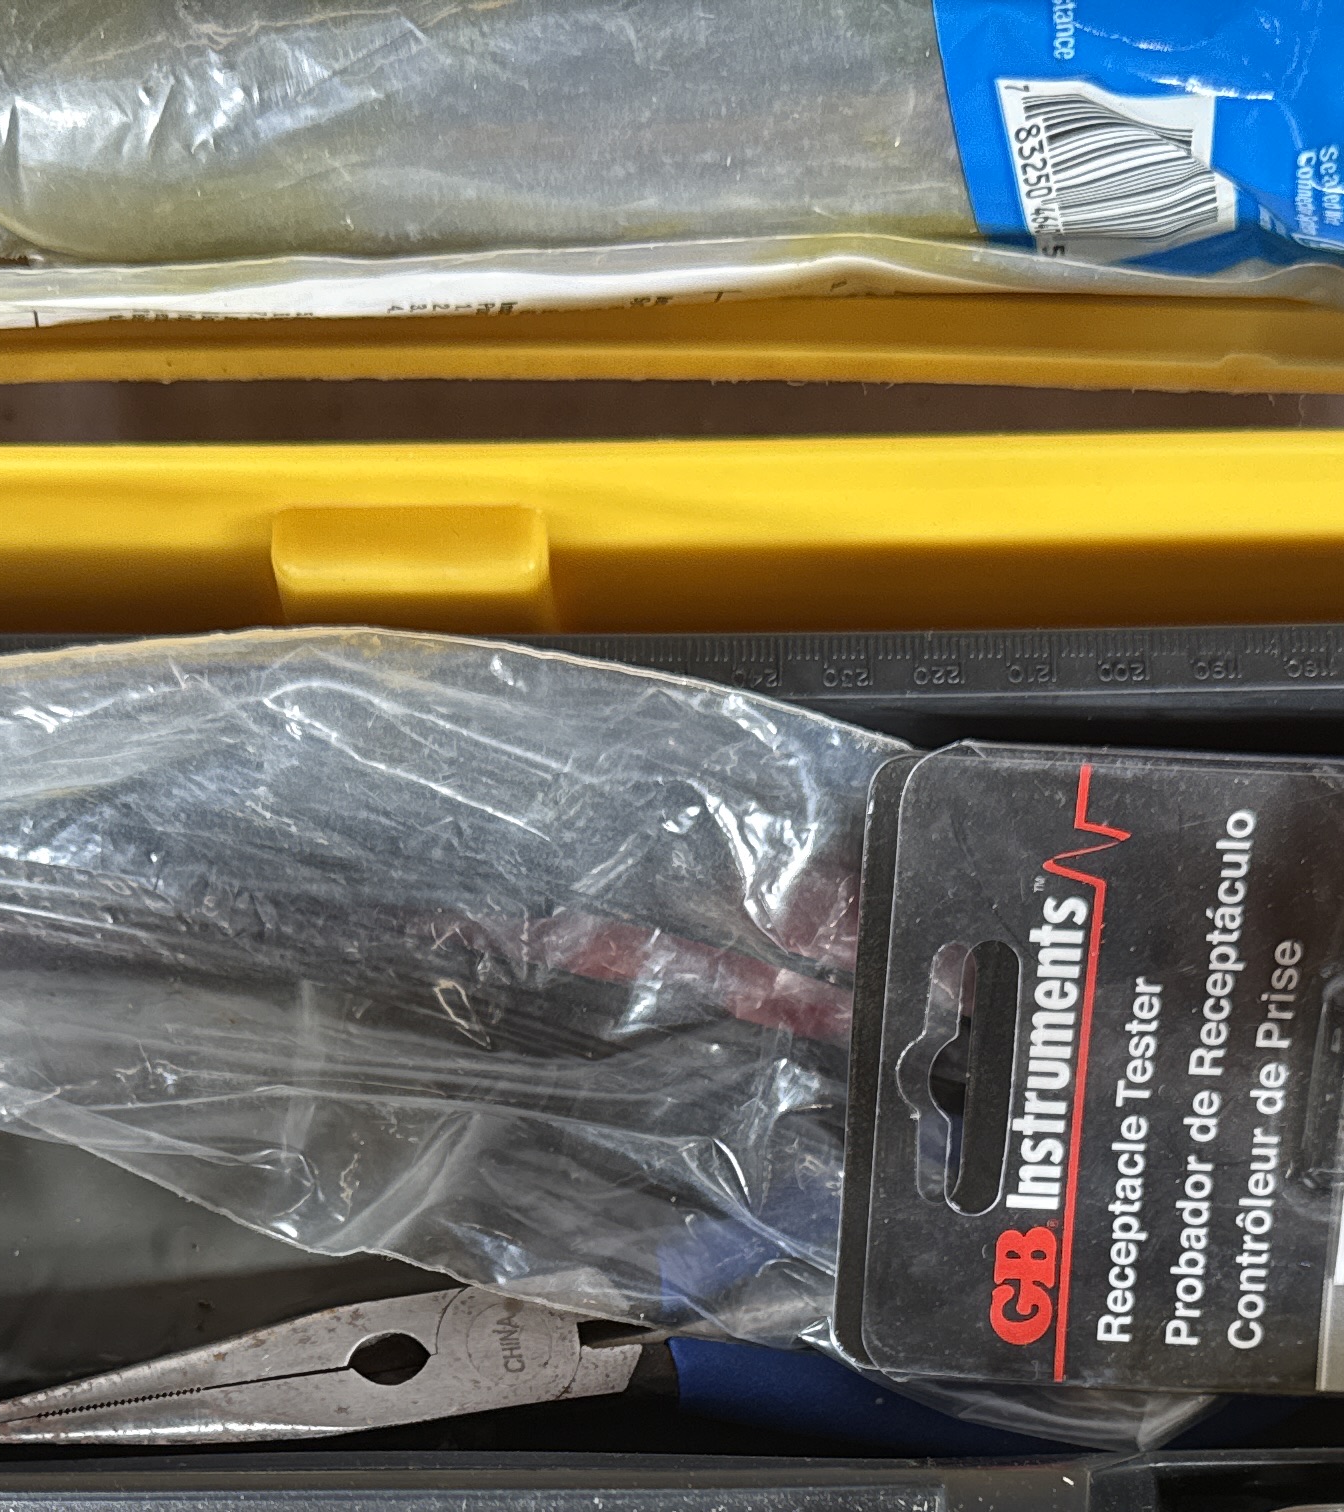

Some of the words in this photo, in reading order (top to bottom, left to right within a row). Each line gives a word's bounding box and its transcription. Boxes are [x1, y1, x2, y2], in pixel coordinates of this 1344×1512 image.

[1003, 84, 1030, 93] 7
[1013, 124, 1052, 199] 83250
[1189, 810, 1256, 1075] Receptáculo
[1255, 940, 1302, 1048] Prise
[1008, 898, 1085, 1208] Instruments
[1116, 977, 1161, 1106] Tester
[1250, 1062, 1288, 1114] de
[1183, 1089, 1220, 1142] de
[990, 1226, 1057, 1343] GB
[1097, 1115, 1148, 1341] Receptacle
[1165, 1155, 1212, 1344] Probador
[1228, 1128, 1279, 1347] Contrôleur
[487, 1312, 530, 1375] CHINA
